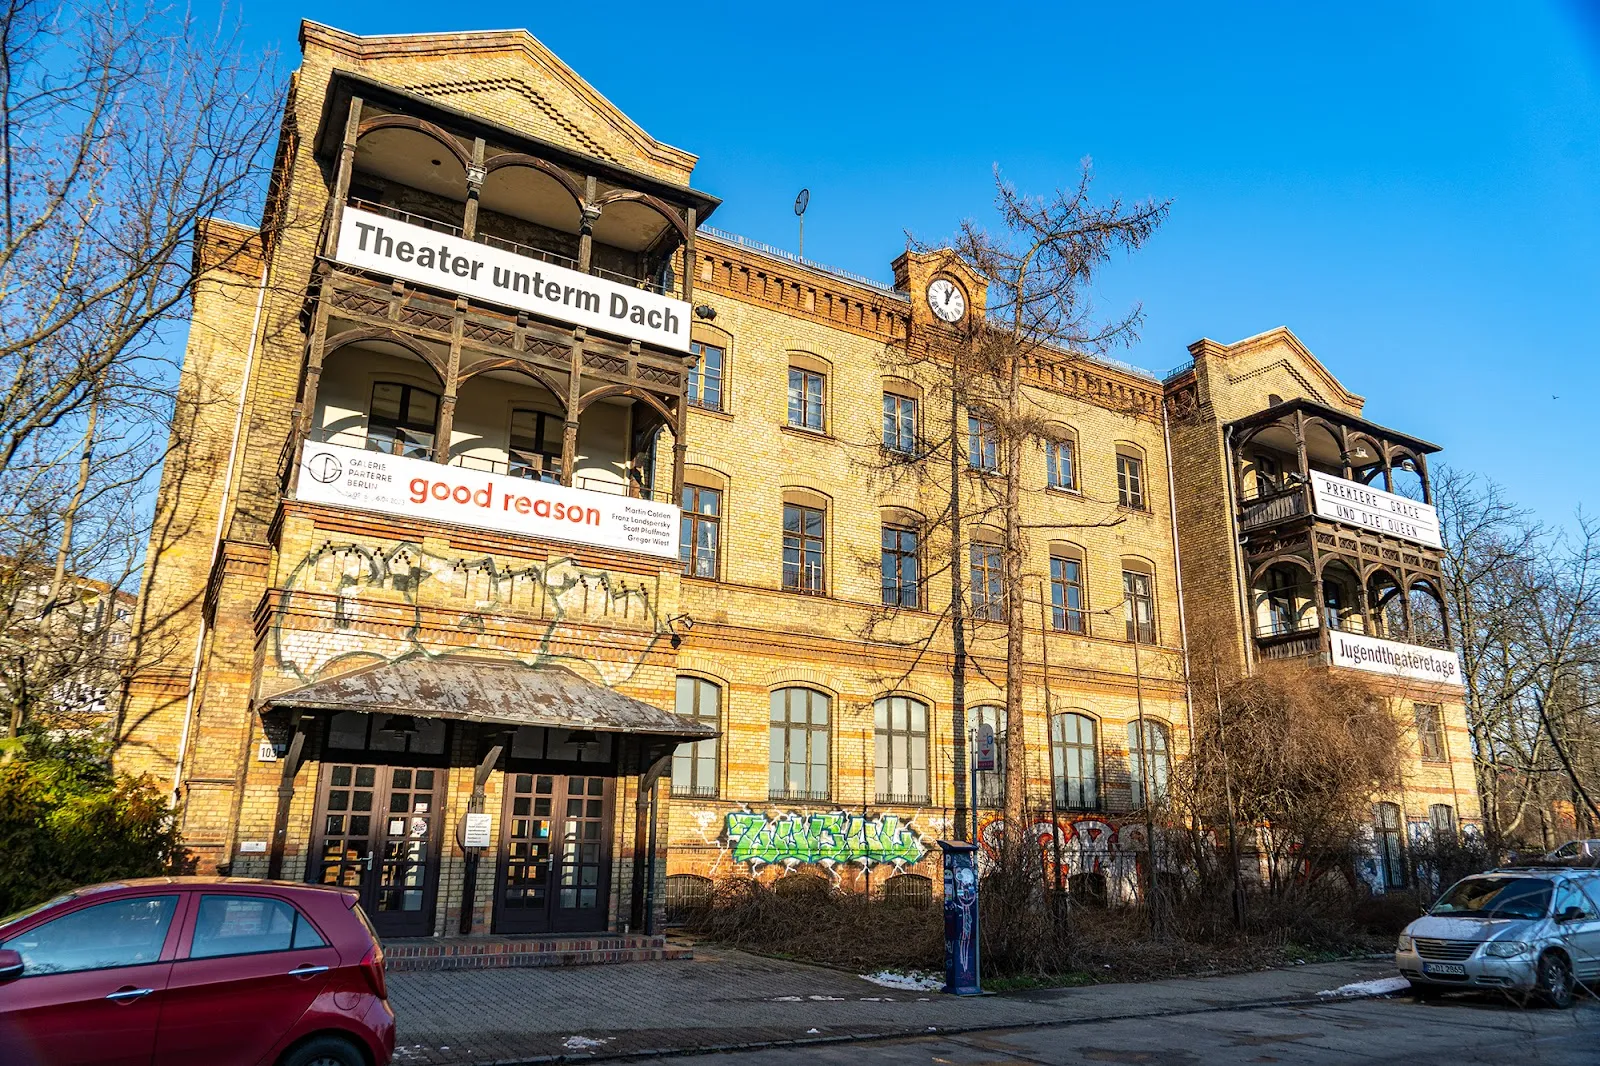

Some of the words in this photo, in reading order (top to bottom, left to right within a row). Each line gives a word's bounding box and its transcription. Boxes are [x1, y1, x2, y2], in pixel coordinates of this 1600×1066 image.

[355, 221, 484, 281] Theater
[492, 266, 600, 314] unterm
[609, 292, 679, 335] Dach
[349, 458, 386, 470] GALERIE
[348, 469, 392, 482] PARTERRE
[347, 479, 378, 489] BERLIN
[409, 477, 493, 509] good
[503, 493, 601, 526] reason
[1326, 482, 1378, 507] PREMIERE
[1390, 500, 1420, 519] GRACE
[625, 506, 647, 516] Martin
[1336, 505, 1355, 520] UND
[1362, 512, 1381, 528] DIE
[611, 513, 630, 522] Franz
[623, 524, 640, 533] Scott
[627, 534, 651, 544] Gregor
[1340, 638, 1455, 679] Jugendtheateretage
[261, 747, 276, 757] 103
